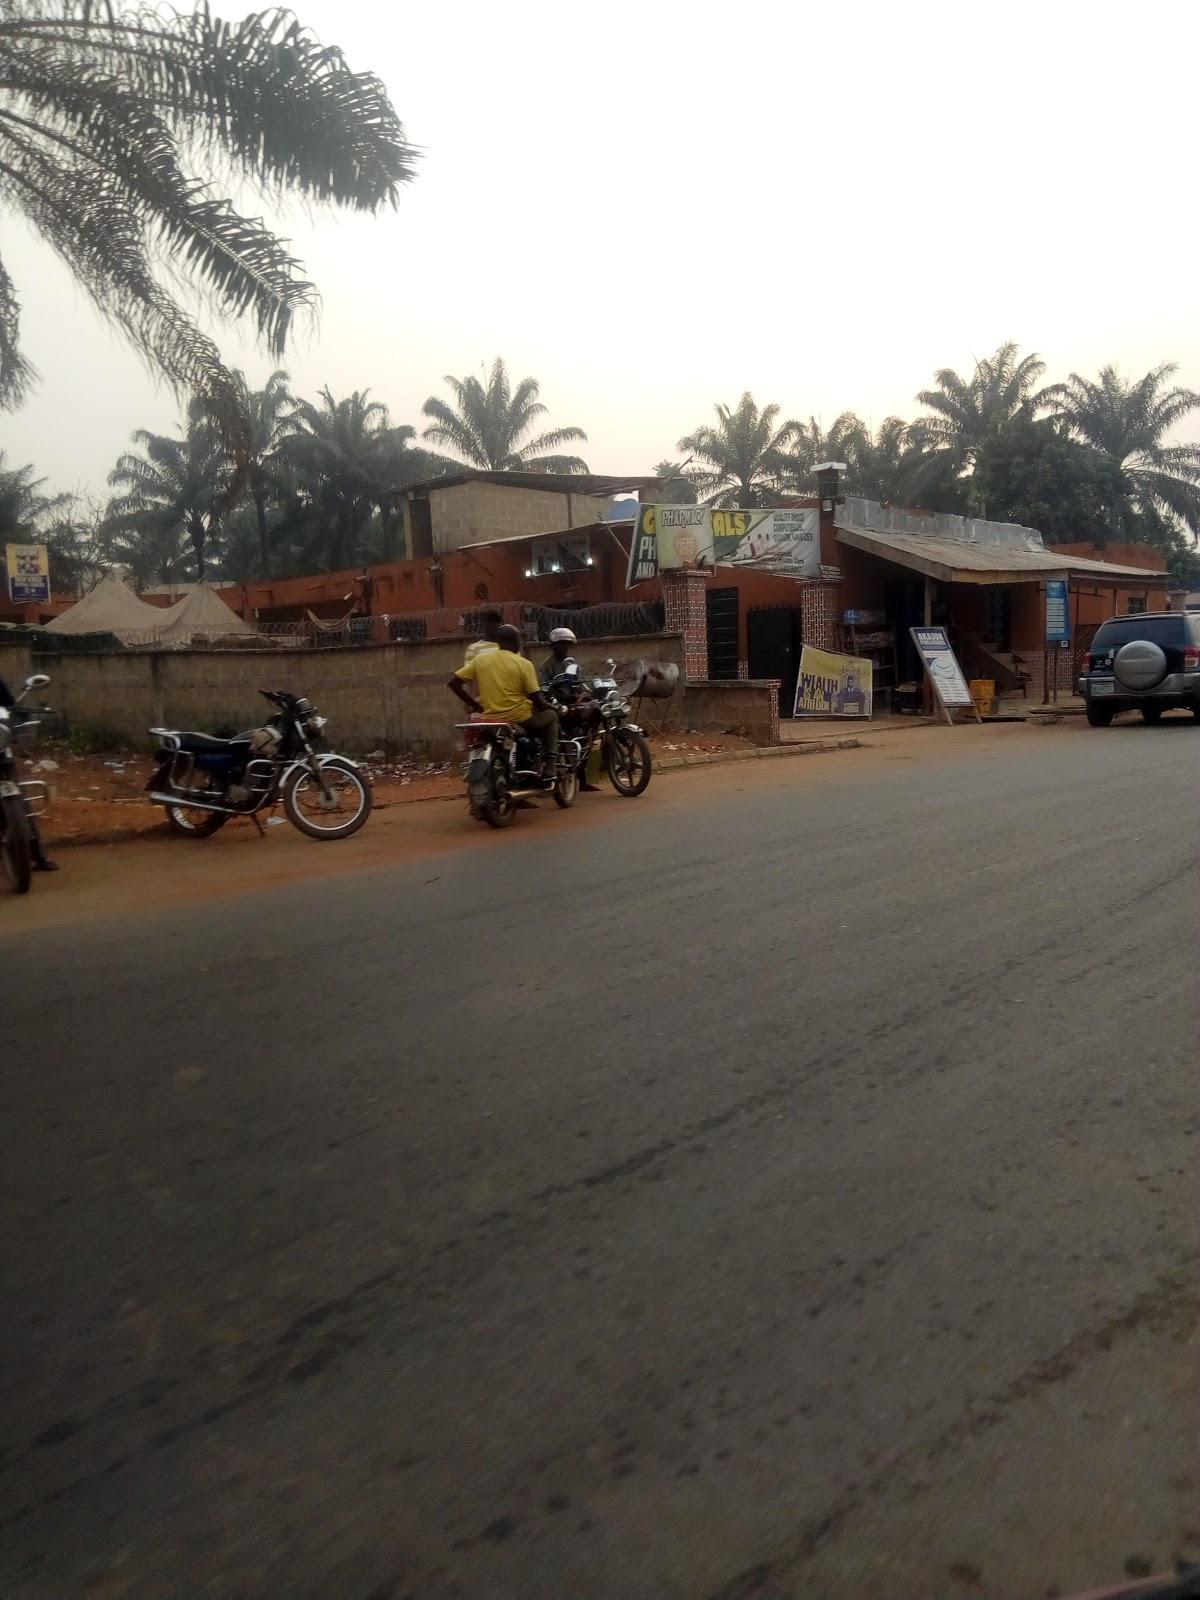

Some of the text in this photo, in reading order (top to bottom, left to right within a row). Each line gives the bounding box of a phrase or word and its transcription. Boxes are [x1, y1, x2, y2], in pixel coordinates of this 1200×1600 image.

[662, 508, 705, 528] PHARMACY
[713, 511, 746, 536] ALS
[638, 536, 656, 560] PH
[635, 562, 656, 579] AND
[801, 672, 838, 692] WEALTH
